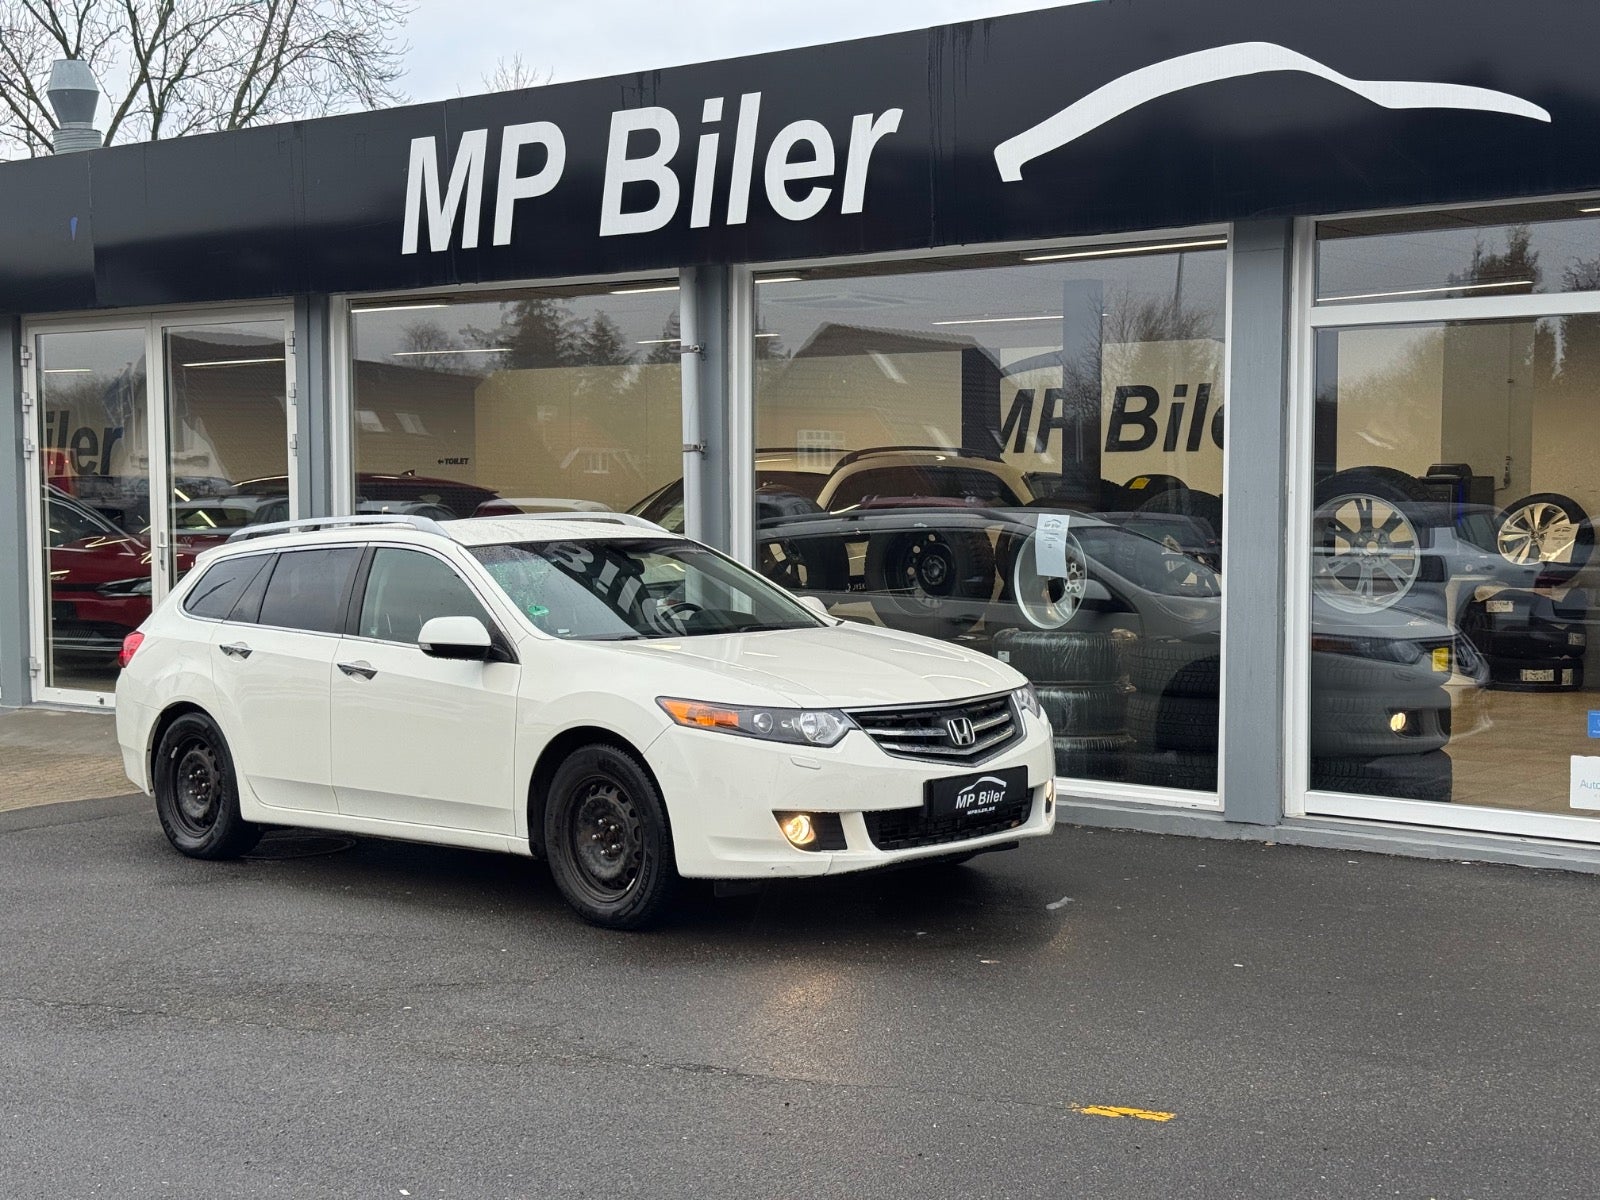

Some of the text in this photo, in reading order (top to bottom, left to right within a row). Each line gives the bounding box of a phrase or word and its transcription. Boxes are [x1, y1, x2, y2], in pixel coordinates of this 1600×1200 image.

[401, 91, 904, 255] MP Biler
[445, 457, 469, 465] TOILET
[955, 790, 1005, 809] MP Biler
